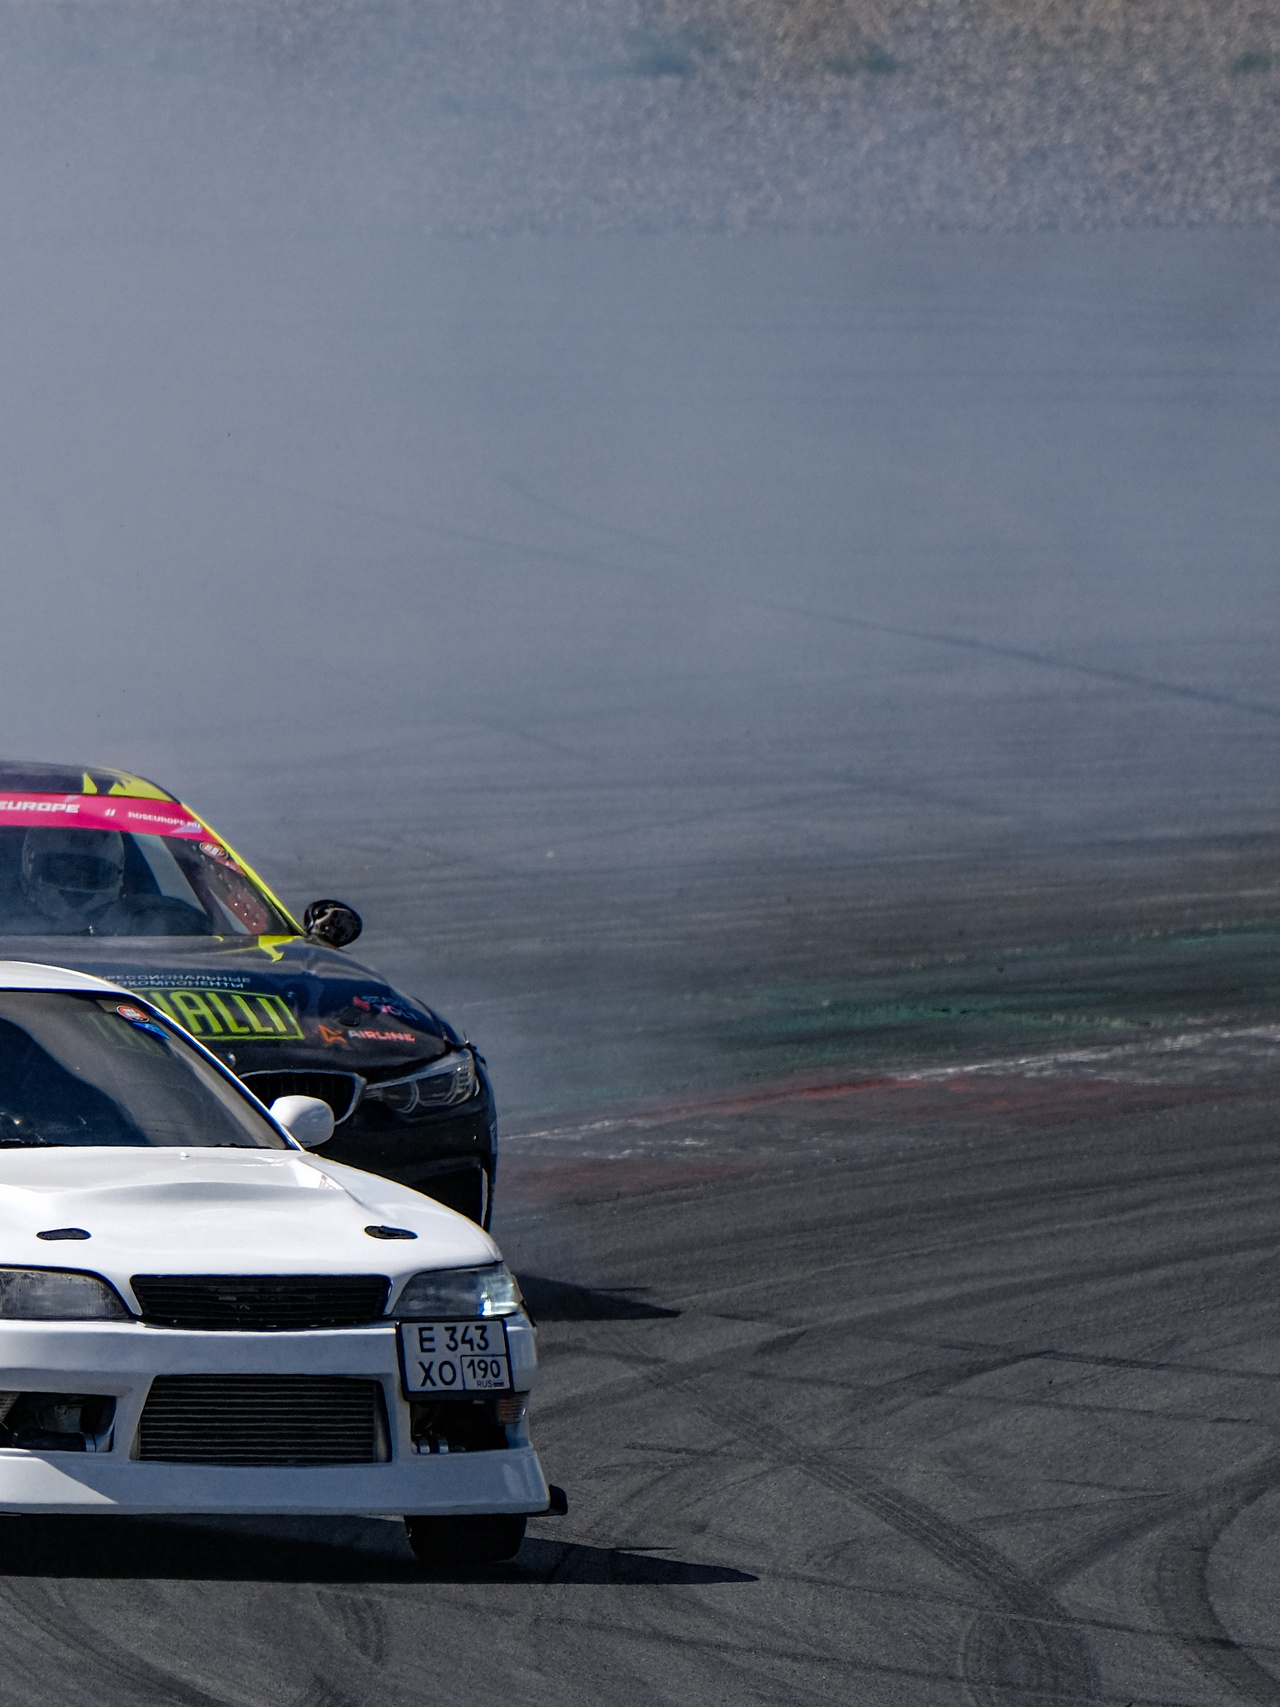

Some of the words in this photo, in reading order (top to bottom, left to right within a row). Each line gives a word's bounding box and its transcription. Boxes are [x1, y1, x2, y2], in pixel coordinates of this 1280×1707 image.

[116, 980, 244, 989] ОКОМПОНЕНТЫ
[348, 1029, 416, 1043] AIRLINE
[418, 1326, 436, 1353] E
[444, 1325, 490, 1352] 343
[418, 1360, 457, 1387] XO
[466, 1359, 501, 1379] 190
[477, 1380, 493, 1388] RUS
